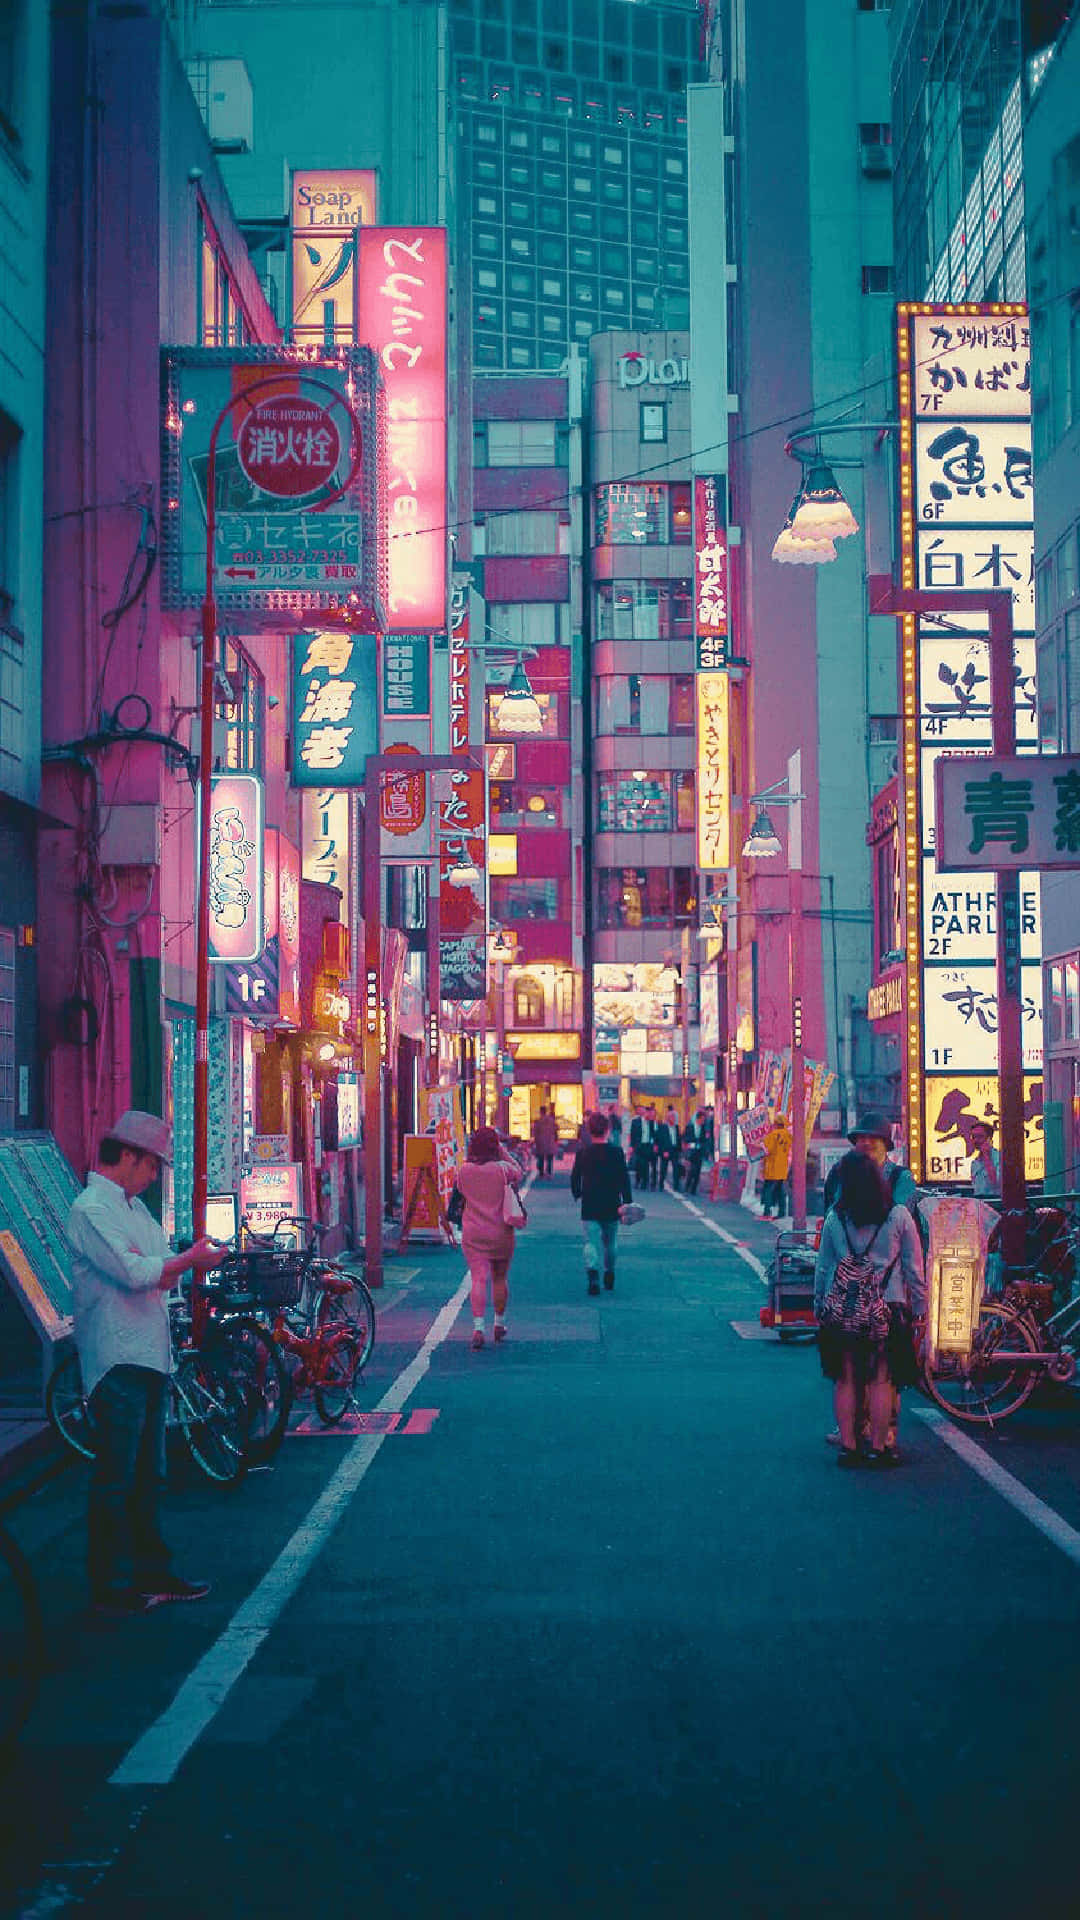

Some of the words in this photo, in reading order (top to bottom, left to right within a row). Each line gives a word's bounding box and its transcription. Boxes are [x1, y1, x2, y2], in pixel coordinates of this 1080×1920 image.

[298, 186, 352, 210] Soap
[308, 206, 362, 225] Land
[921, 394, 943, 411] 7F
[256, 410, 277, 421] FIRE
[280, 410, 324, 421] HYDRANT
[248, 426, 333, 466] 消火栓
[922, 503, 945, 520] 6F
[925, 537, 1035, 587] 白木
[696, 543, 727, 627] 甘太郎
[700, 637, 725, 652] 4F
[700, 653, 725, 668] 3F
[387, 645, 414, 710] HOUSE
[925, 717, 948, 735] 4F
[703, 703, 723, 865] やきとりセンター
[931, 892, 1036, 912] ATHRE
[931, 915, 1036, 934] PARLR
[928, 938, 951, 955] 2F
[238, 973, 266, 1002] 1F
[931, 1048, 953, 1065] 1F
[931, 1157, 965, 1174] B1F
[947, 1273, 966, 1336] 営業中
